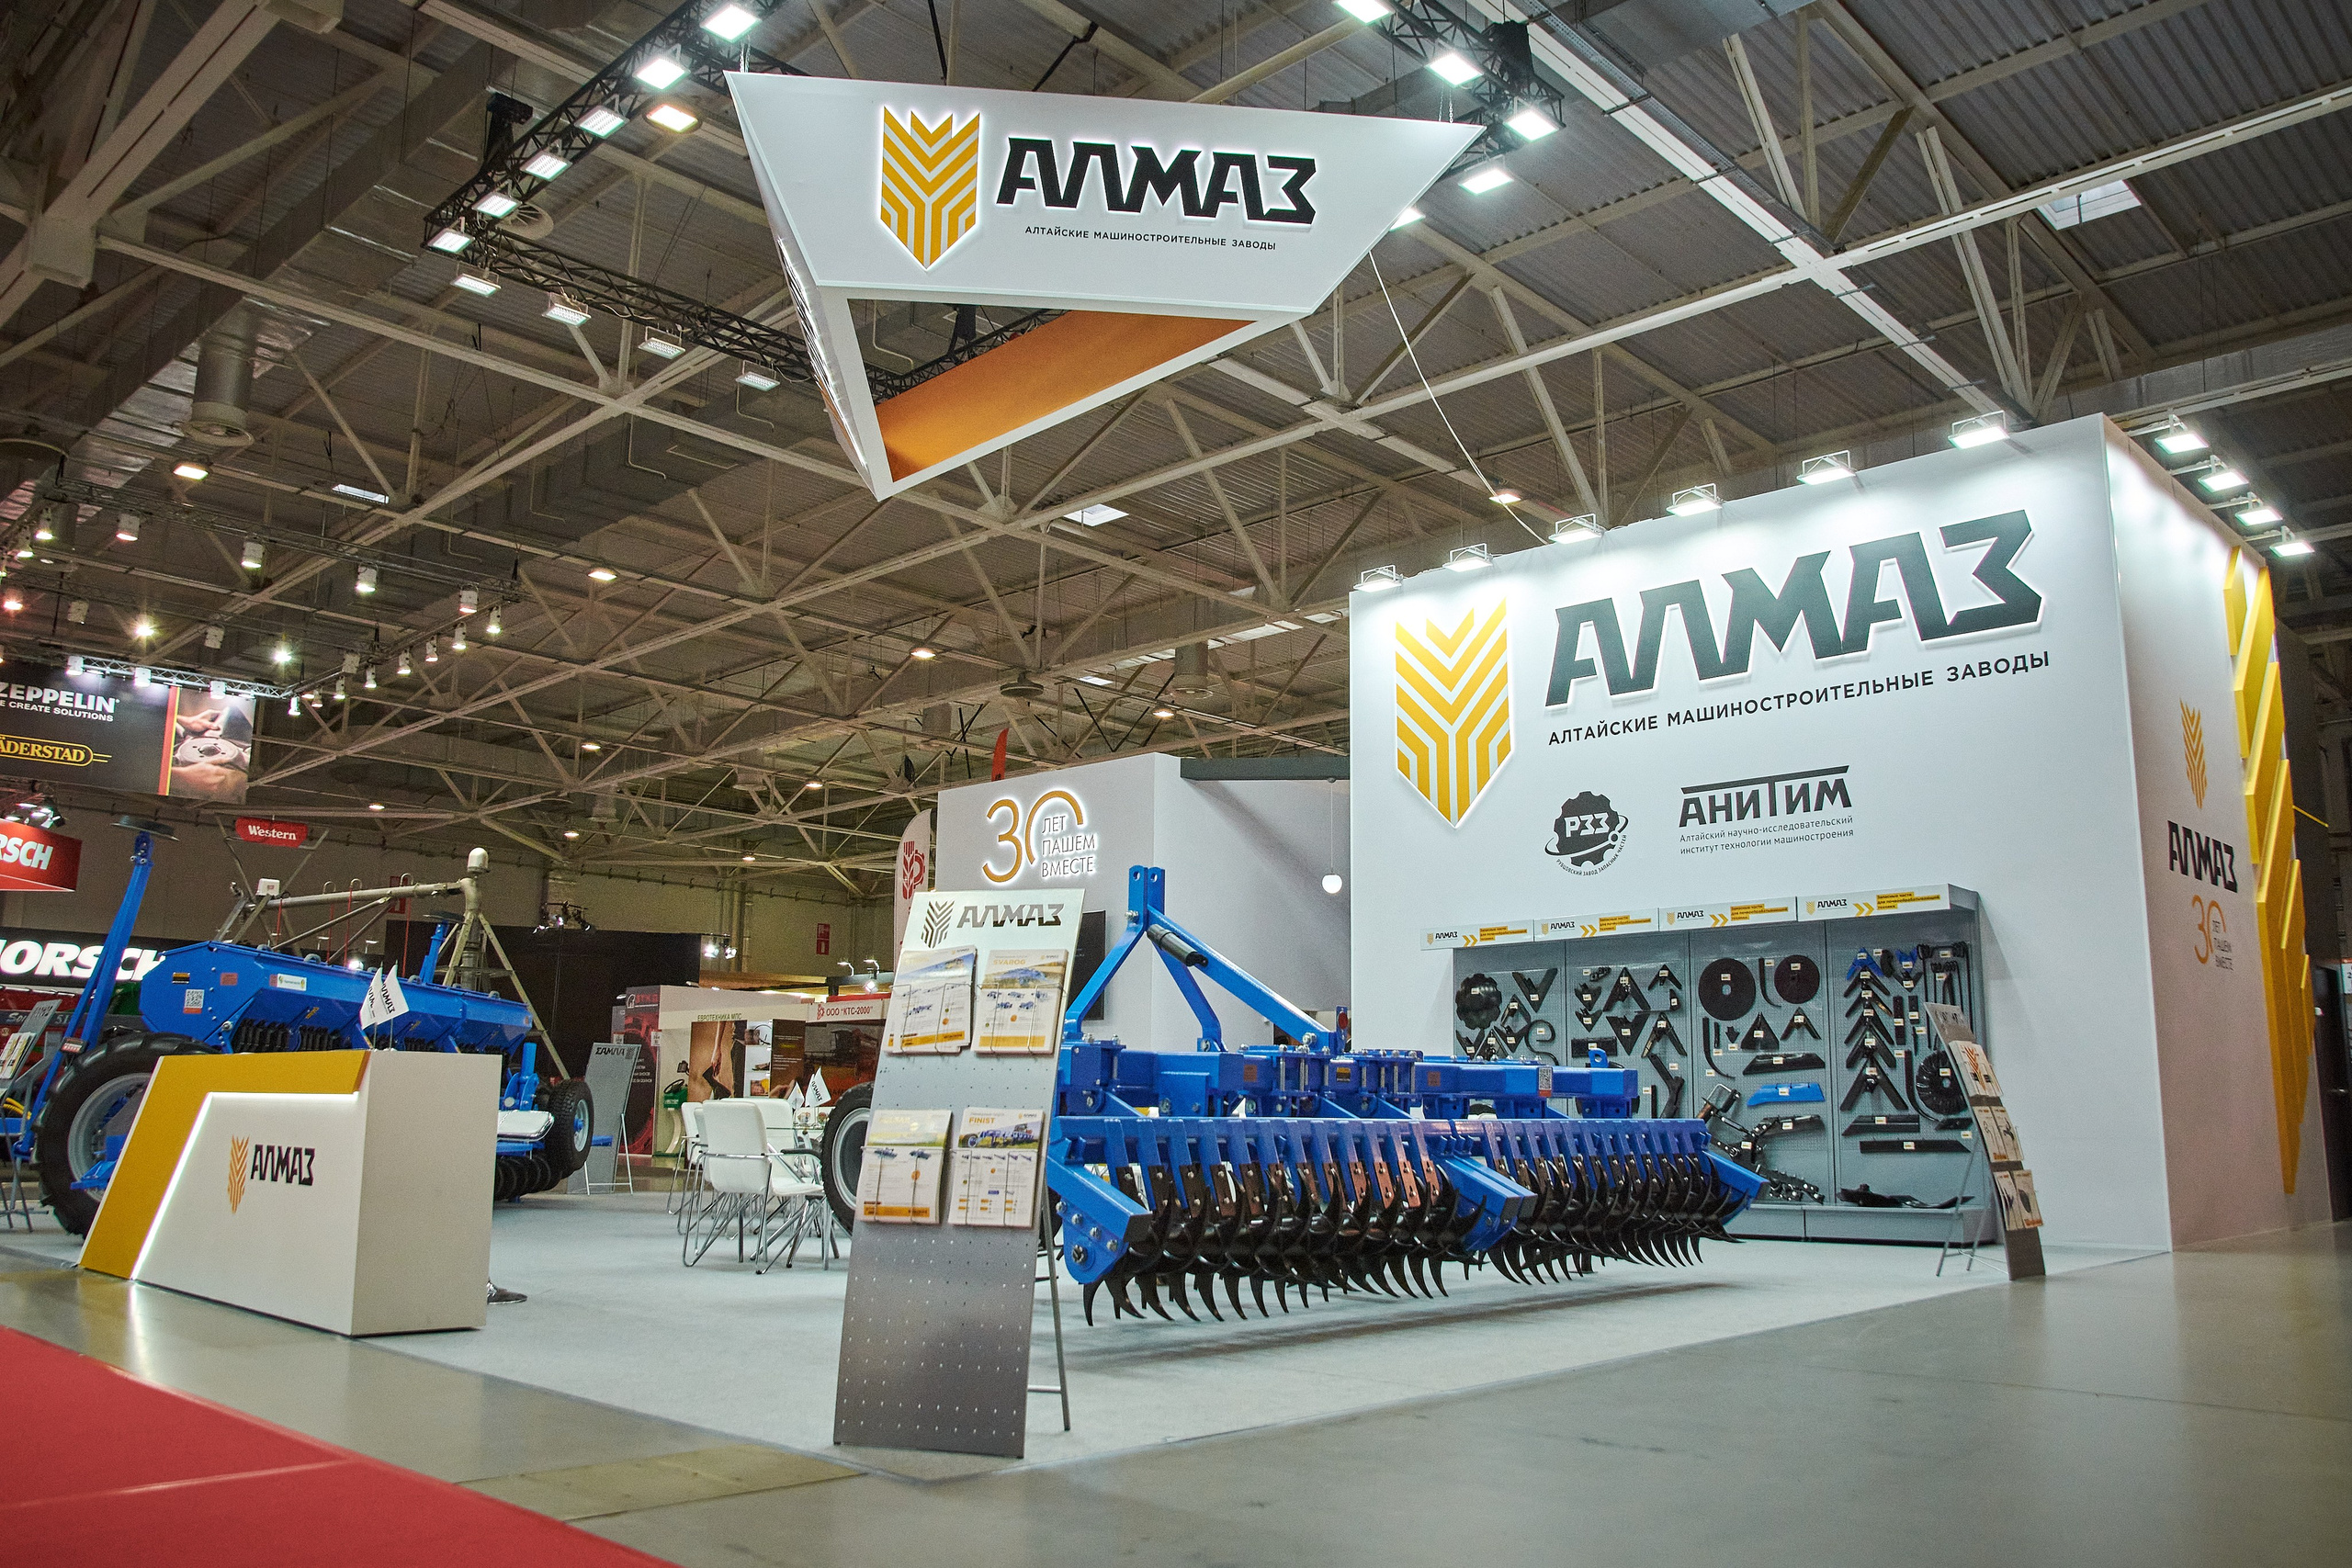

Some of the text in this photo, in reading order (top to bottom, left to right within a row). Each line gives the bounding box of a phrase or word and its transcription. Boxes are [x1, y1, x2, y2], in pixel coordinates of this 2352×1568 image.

[996, 137, 1317, 225] АЛМАЗ
[1024, 225, 1276, 251] АЛТАЙСКИЕ МАШИНОСТРОИТЕЛЬНЫЕ ЗАВОДЫ
[1545, 509, 2042, 706] АЛМАЗ
[1548, 650, 2050, 746] АЛТАЙСКИЕ МАШИНОСТРОИТЕЛЬНЫЕ ЗАВОДЫ
[8, 701, 51, 713] CREATE
[53, 706, 114, 722] SOLUTIONS
[1679, 765, 1852, 827] АНИТИМ
[248, 825, 297, 840] Western
[1042, 816, 1066, 834] ЛЕТ
[1564, 812, 1611, 838] РЗЗ
[1679, 815, 1853, 843] Алтайский научно-исследовательский
[1042, 834, 1095, 855] ПАШЕМ
[1680, 829, 1854, 855] институт технологии машиностроения
[1042, 856, 1093, 878] ВМЕСТЕ
[1582, 869, 1599, 877] ЗАВОД
[1598, 854, 1620, 873] ЗАПАСНЫХ
[1617, 834, 1627, 853] ЧАСТЕЙ
[2167, 820, 2238, 893] АЛМАЗ
[956, 904, 1064, 928] АЛМАЗ
[1677, 910, 1703, 919] АЛМАЗ
[1817, 898, 1847, 908] АЛМАЗ
[1435, 931, 1458, 940] АЛМАЗ
[1550, 921, 1575, 930] АЛМАЗ
[0, 939, 166, 981] ORSCH
[251, 1144, 315, 1186] АЛМАЗ
